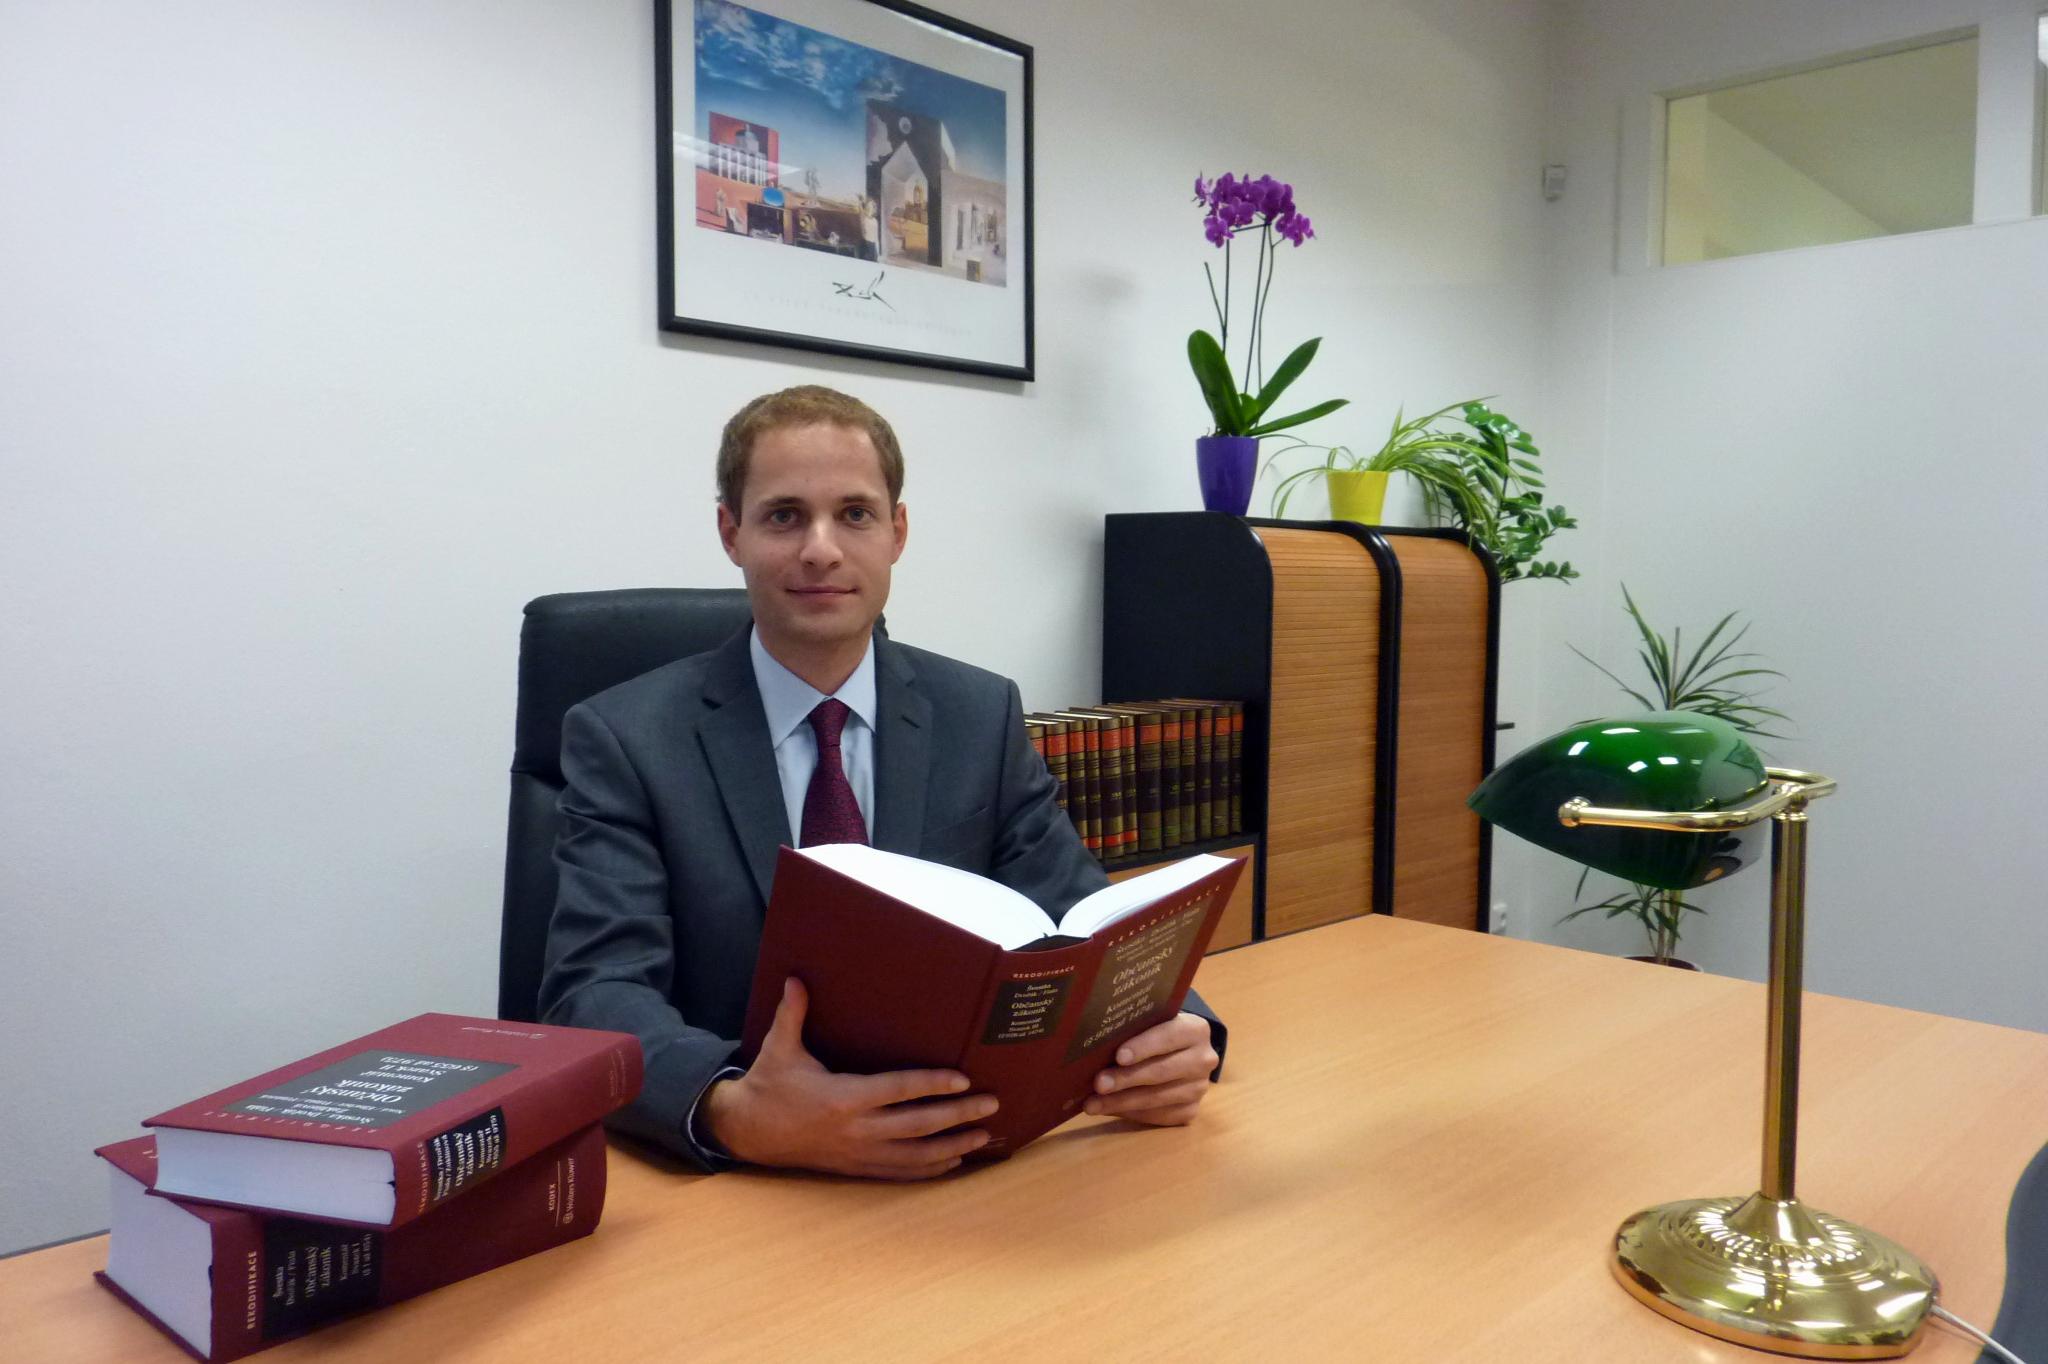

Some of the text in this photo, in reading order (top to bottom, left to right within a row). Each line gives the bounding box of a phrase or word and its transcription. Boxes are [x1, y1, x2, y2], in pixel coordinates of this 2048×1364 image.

[1012, 965, 1075, 978] REKODIFIKACE
[1112, 945, 1174, 985] Občanský
[1011, 997, 1054, 1009] Občanský
[300, 1086, 402, 1103] Občanský
[335, 1079, 414, 1093] zákoník
[359, 1070, 435, 1083] Komentář
[453, 1132, 465, 1187] Občanský
[464, 1132, 474, 1176] zákoník
[548, 1183, 557, 1211] KODEX
[566, 1157, 576, 1212] Wolters Kluwer
[304, 1246, 319, 1298] Občanský
[320, 1246, 331, 1287] zákoník
[247, 1250, 257, 1330] REKODIFIKACE
